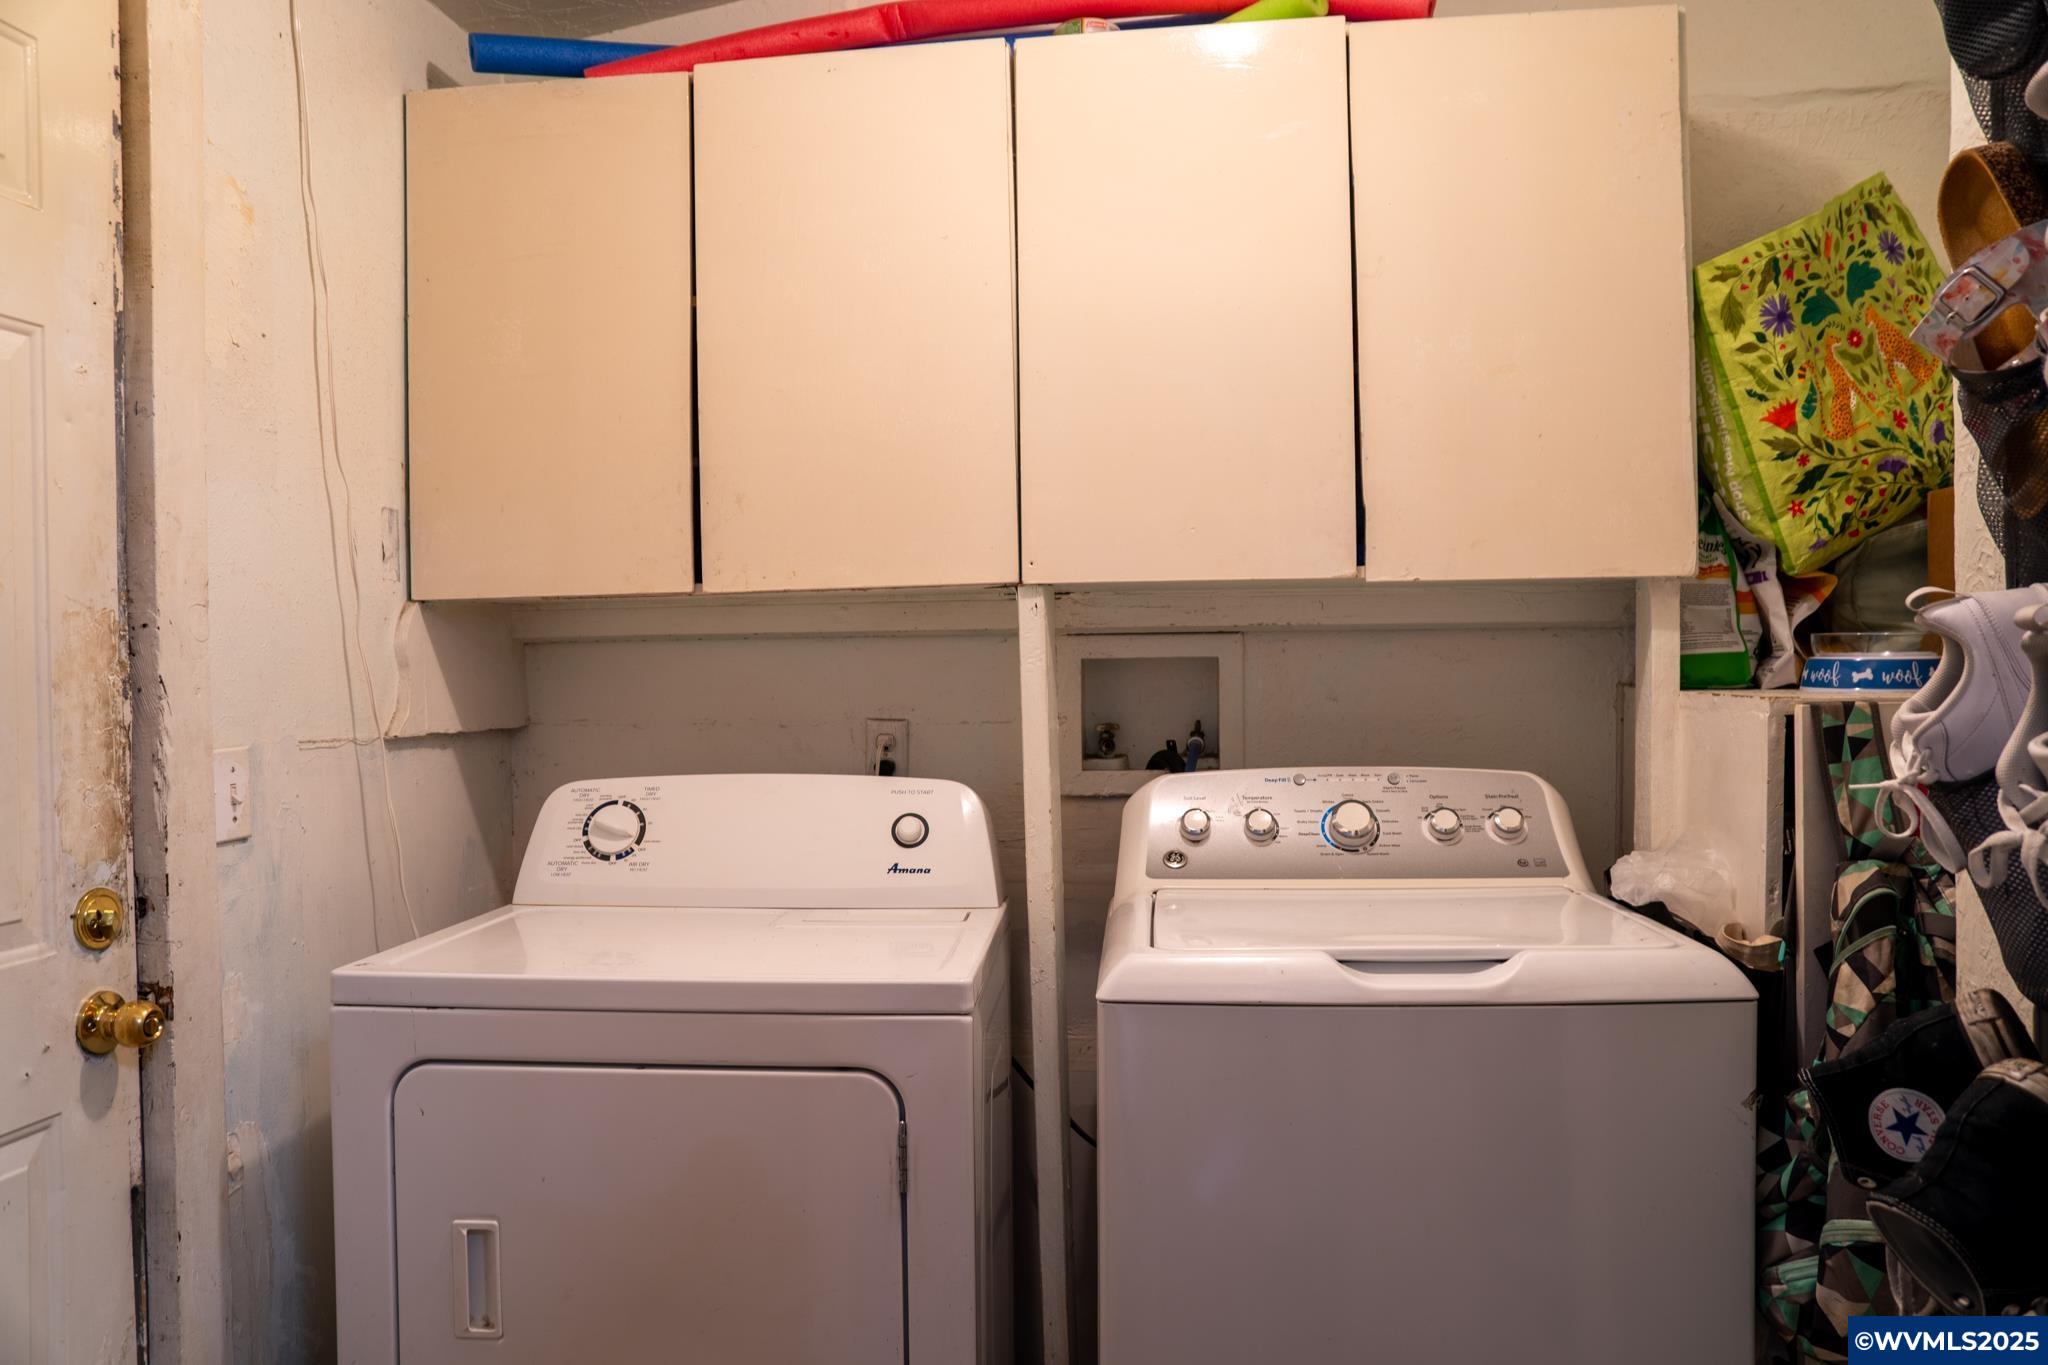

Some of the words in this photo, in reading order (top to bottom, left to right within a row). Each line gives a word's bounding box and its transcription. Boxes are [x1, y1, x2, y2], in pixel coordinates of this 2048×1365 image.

[1728, 482, 1752, 521] Shop
[1810, 660, 1841, 687] woof
[1882, 660, 1923, 687] woof
[887, 862, 932, 875] Amana
[1914, 1098, 1940, 1126] STAR
[1872, 1099, 1905, 1157] CONVERSE
